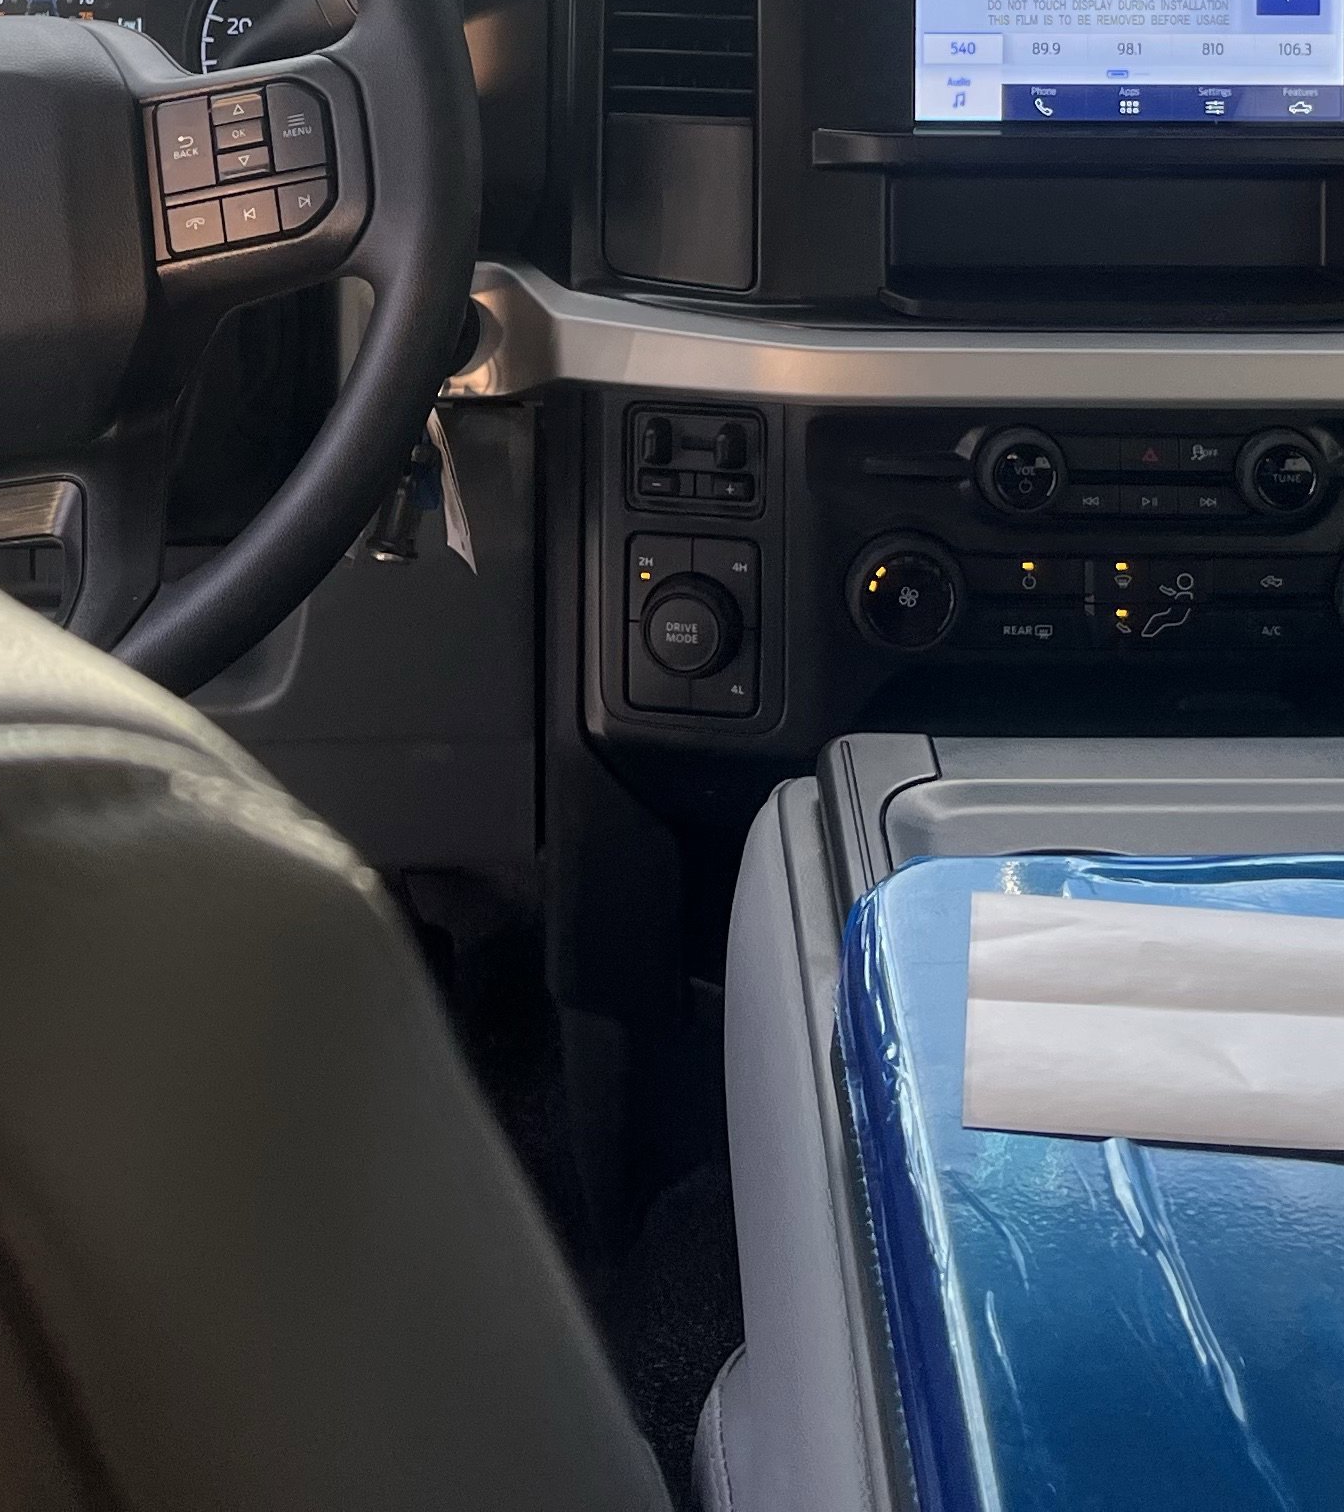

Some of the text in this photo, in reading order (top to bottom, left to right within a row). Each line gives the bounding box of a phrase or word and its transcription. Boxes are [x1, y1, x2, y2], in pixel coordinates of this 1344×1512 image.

[987, 0, 1229, 11] DO NOT TOUCH DISPLAY DURING INSTALLATION
[987, 14, 1230, 26] THIS FILM IS TO BE REMOVED BEFORE USAGE
[950, 42, 976, 55] 540
[1031, 42, 1061, 55] 89.9
[1116, 42, 1142, 55] 98.1
[1201, 42, 1224, 55] 810
[1278, 42, 1312, 56] 106.3
[947, 77, 971, 87] Audio
[1031, 87, 1057, 96] Phone
[1118, 87, 1141, 98] Apps
[1198, 87, 1233, 98] Settings
[1282, 87, 1319, 97] Features
[231, 129, 246, 139] OK
[282, 126, 312, 138] MENU
[173, 148, 199, 160] BACK
[1014, 466, 1035, 476] VOL
[1272, 473, 1302, 483] TUNE
[638, 556, 654, 567] 2H
[732, 562, 748, 573] 4H
[665, 621, 699, 633] DRIVE
[1002, 625, 1033, 636] REAR
[1261, 625, 1281, 636] A/C
[665, 632, 699, 644] MODE
[731, 685, 745, 695] 4L
